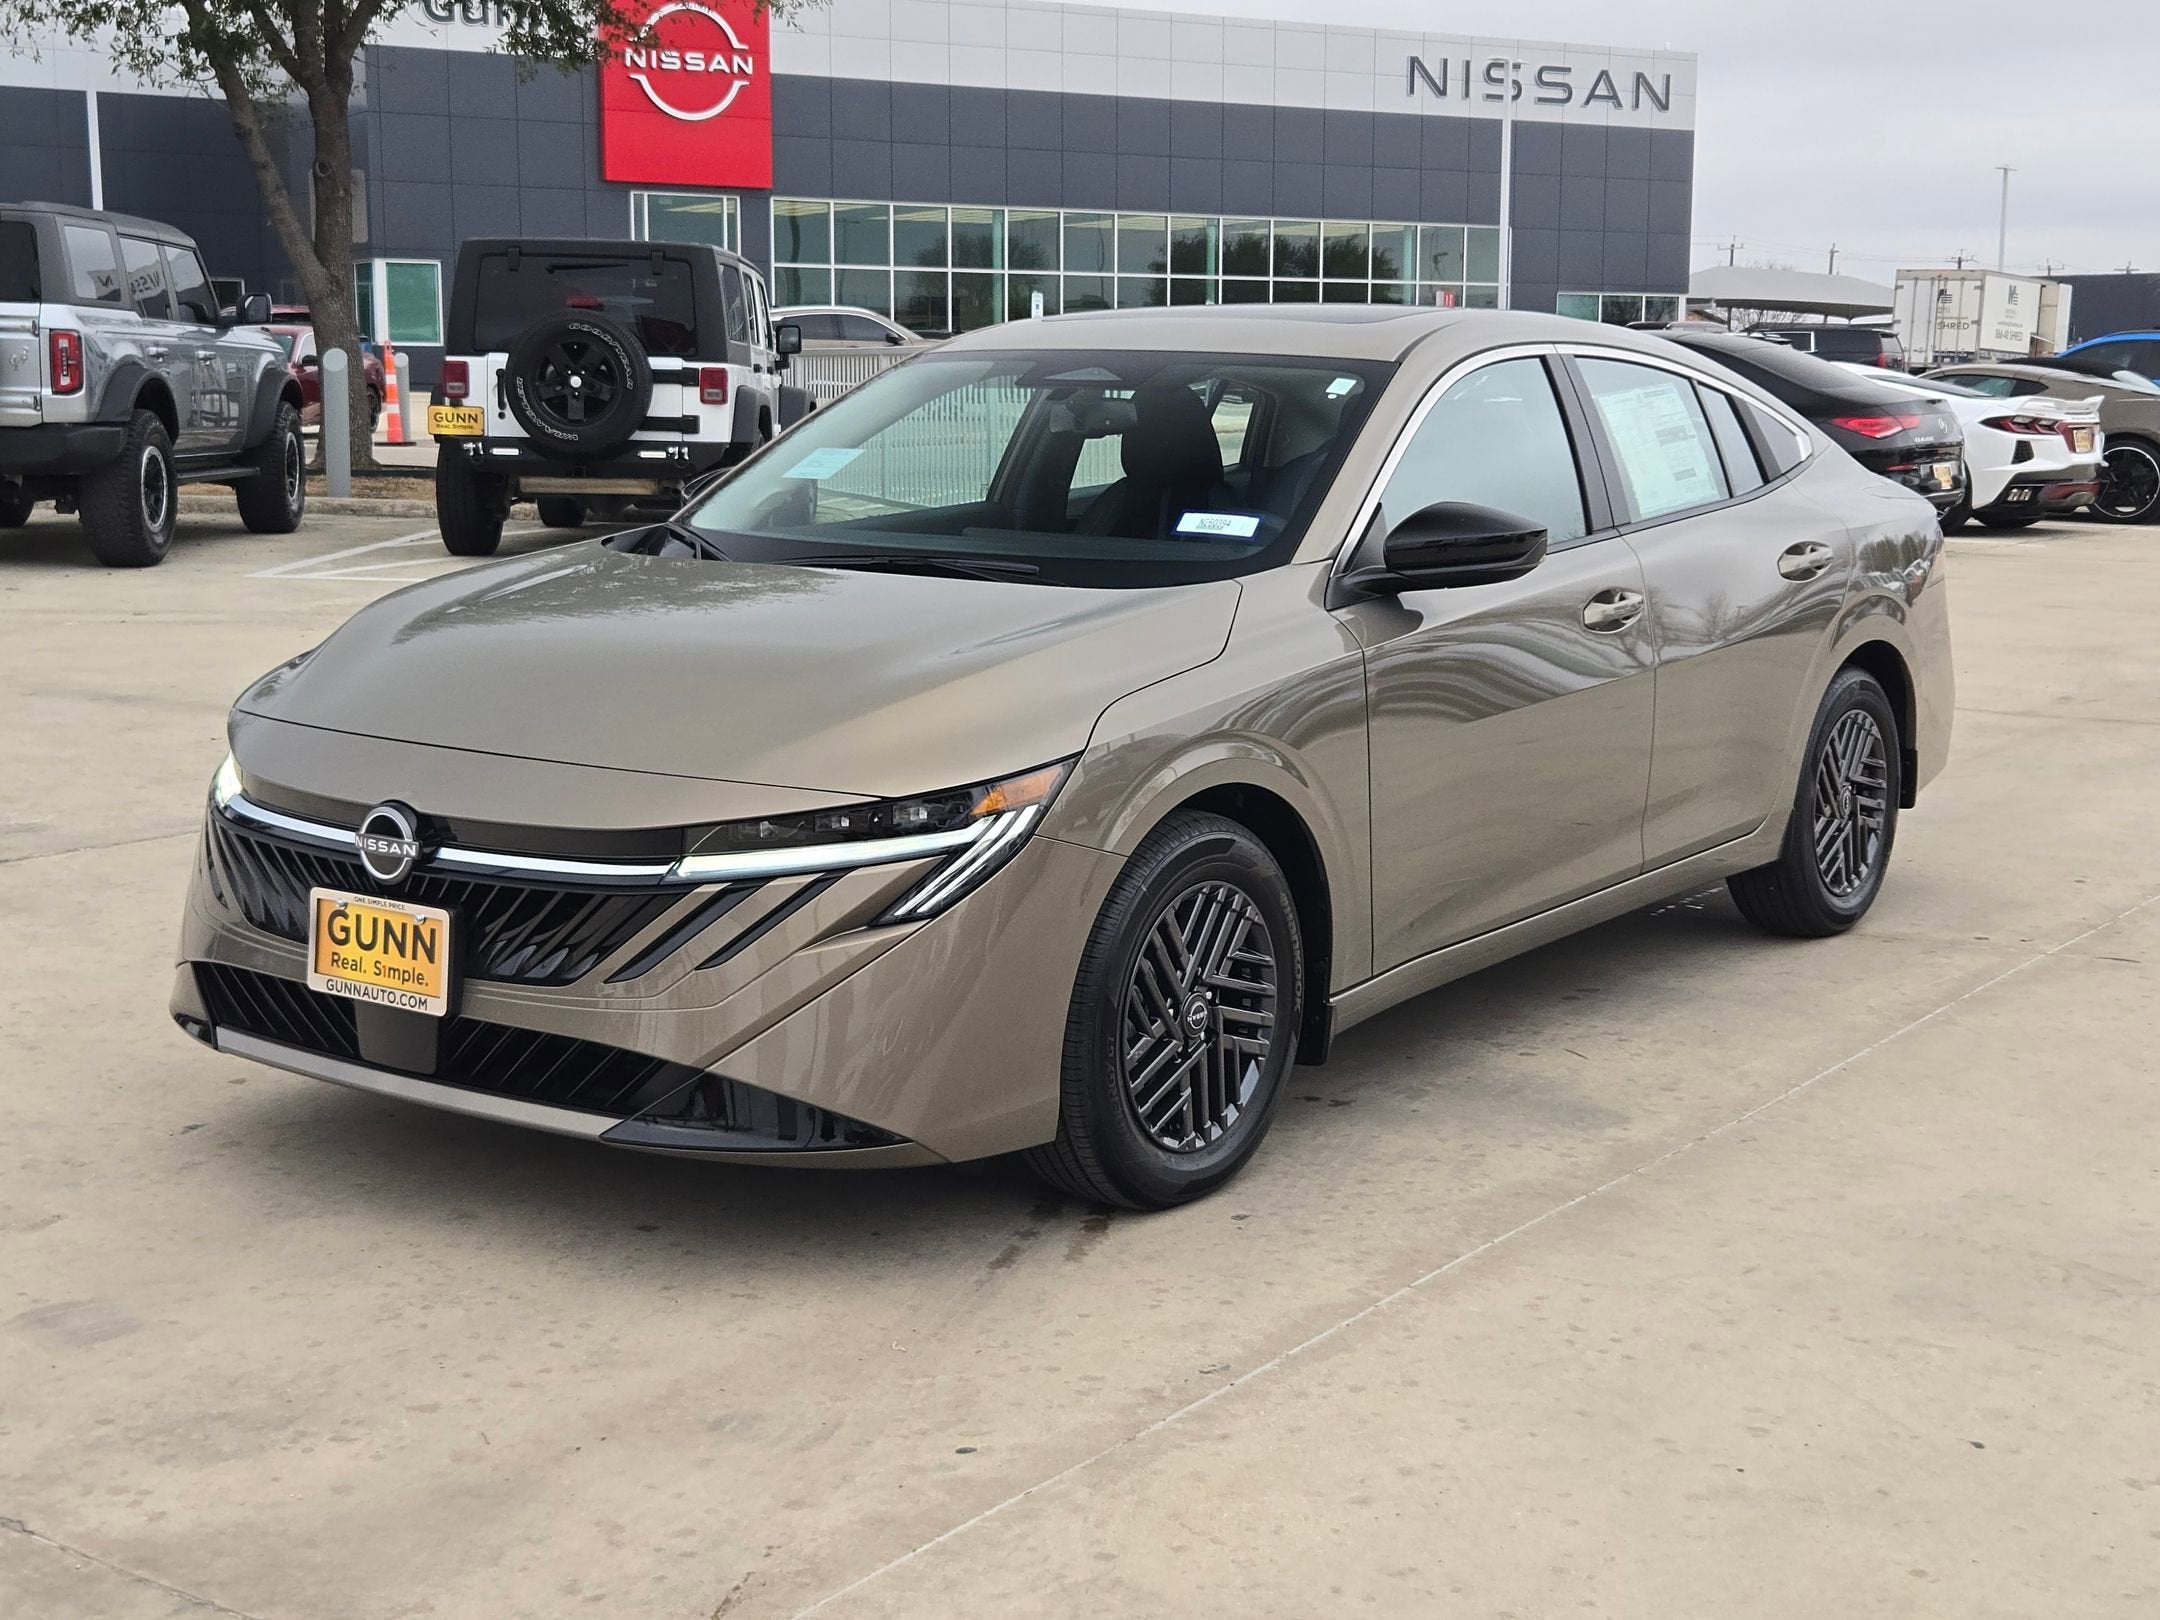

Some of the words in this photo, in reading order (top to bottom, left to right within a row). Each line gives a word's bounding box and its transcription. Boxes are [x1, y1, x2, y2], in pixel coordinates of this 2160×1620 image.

[625, 48, 753, 75] NISSAN
[1407, 55, 1671, 112] NISSAN
[1937, 321, 1970, 330] SHRED
[433, 412, 479, 424] GUNN
[355, 835, 417, 857] NISSAN
[354, 896, 366, 904] ONE
[367, 898, 387, 908] SIMPLE
[388, 901, 406, 911] PRICE
[327, 909, 437, 965] GUNN
[331, 951, 367, 974] Real.
[326, 978, 428, 1011] GUNNAUTO.COM
